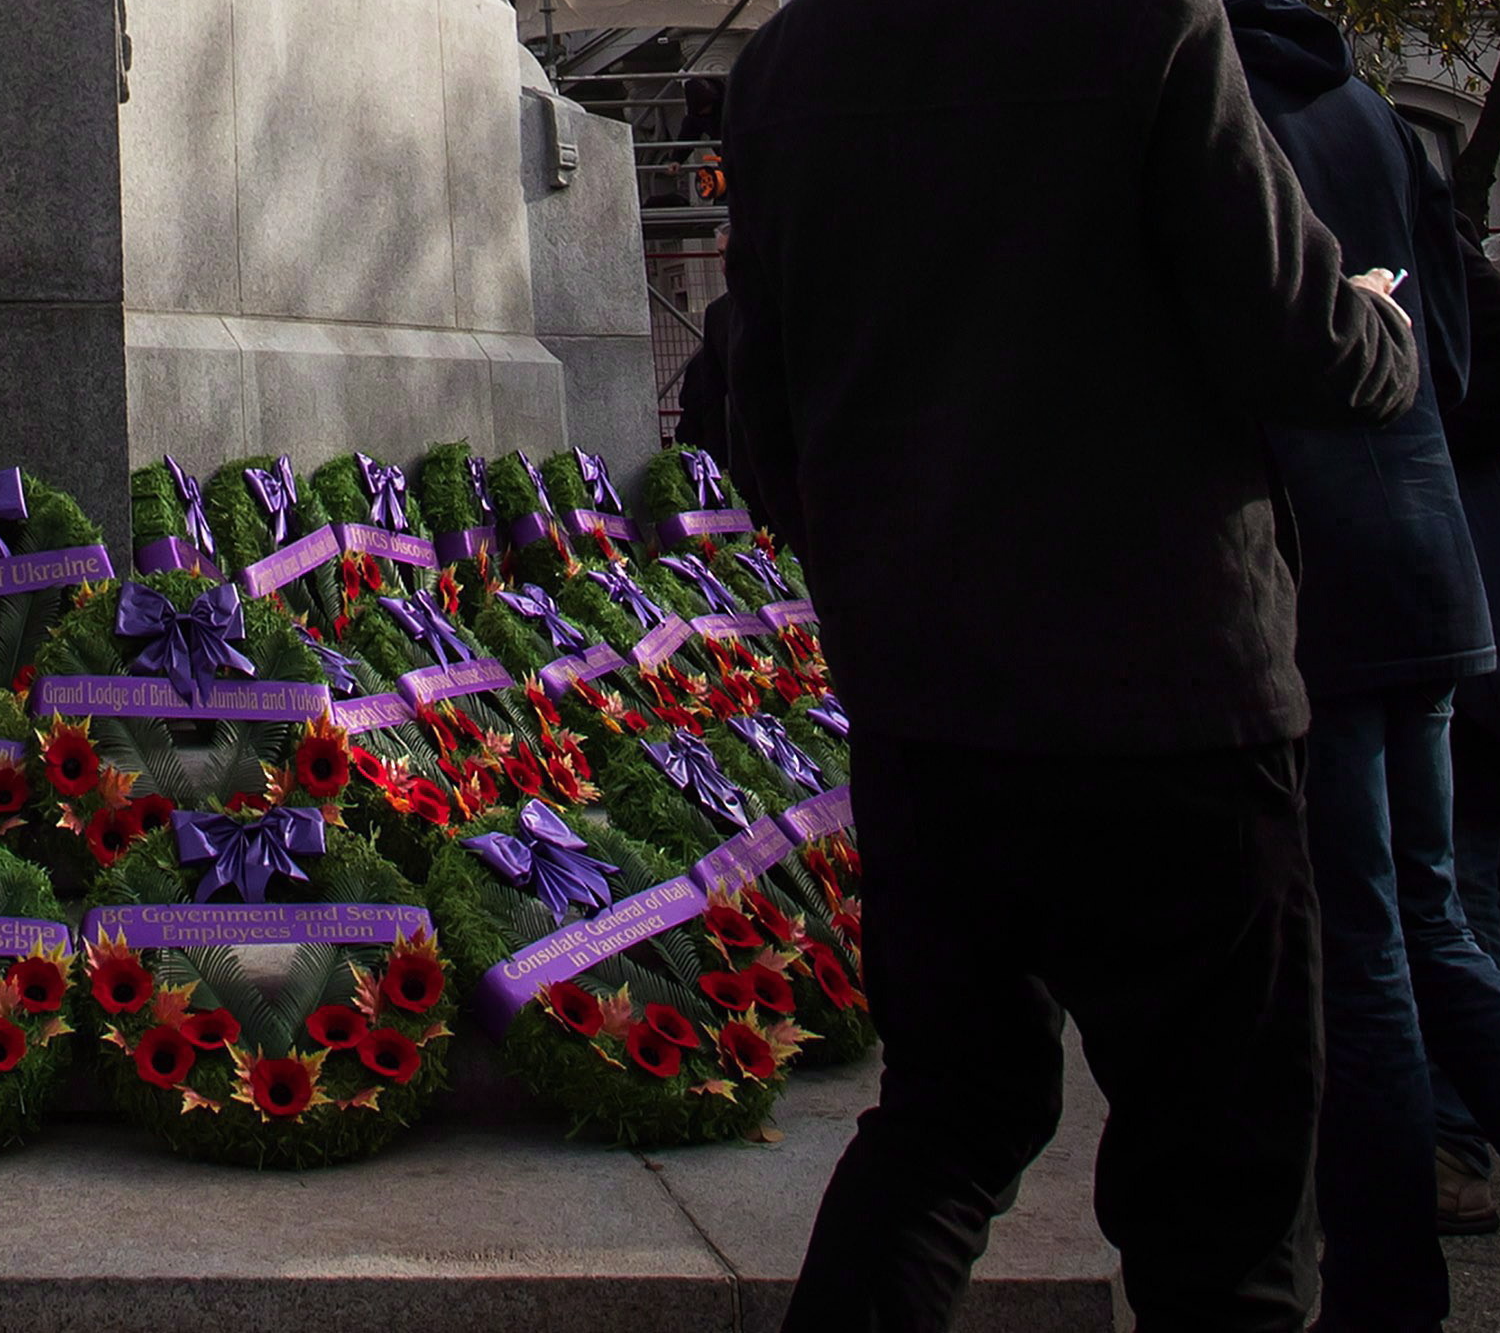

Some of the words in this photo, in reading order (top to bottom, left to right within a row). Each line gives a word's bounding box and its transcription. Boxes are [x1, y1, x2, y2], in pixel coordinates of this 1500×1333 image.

[351, 527, 388, 550] HMCS
[12, 556, 100, 585] Ukraine
[43, 682, 83, 705] Grand
[88, 683, 130, 710] Lodge
[133, 683, 147, 706] of
[262, 687, 286, 710] and
[101, 908, 134, 925] BC
[142, 907, 285, 924] Government
[295, 907, 338, 923] and
[346, 907, 430, 924] Service
[503, 930, 588, 980] Consulate
[585, 900, 647, 937] General
[645, 892, 663, 911] of
[659, 879, 695, 904] Italy
[306, 923, 374, 939] Union
[586, 913, 666, 956] Vancouver
